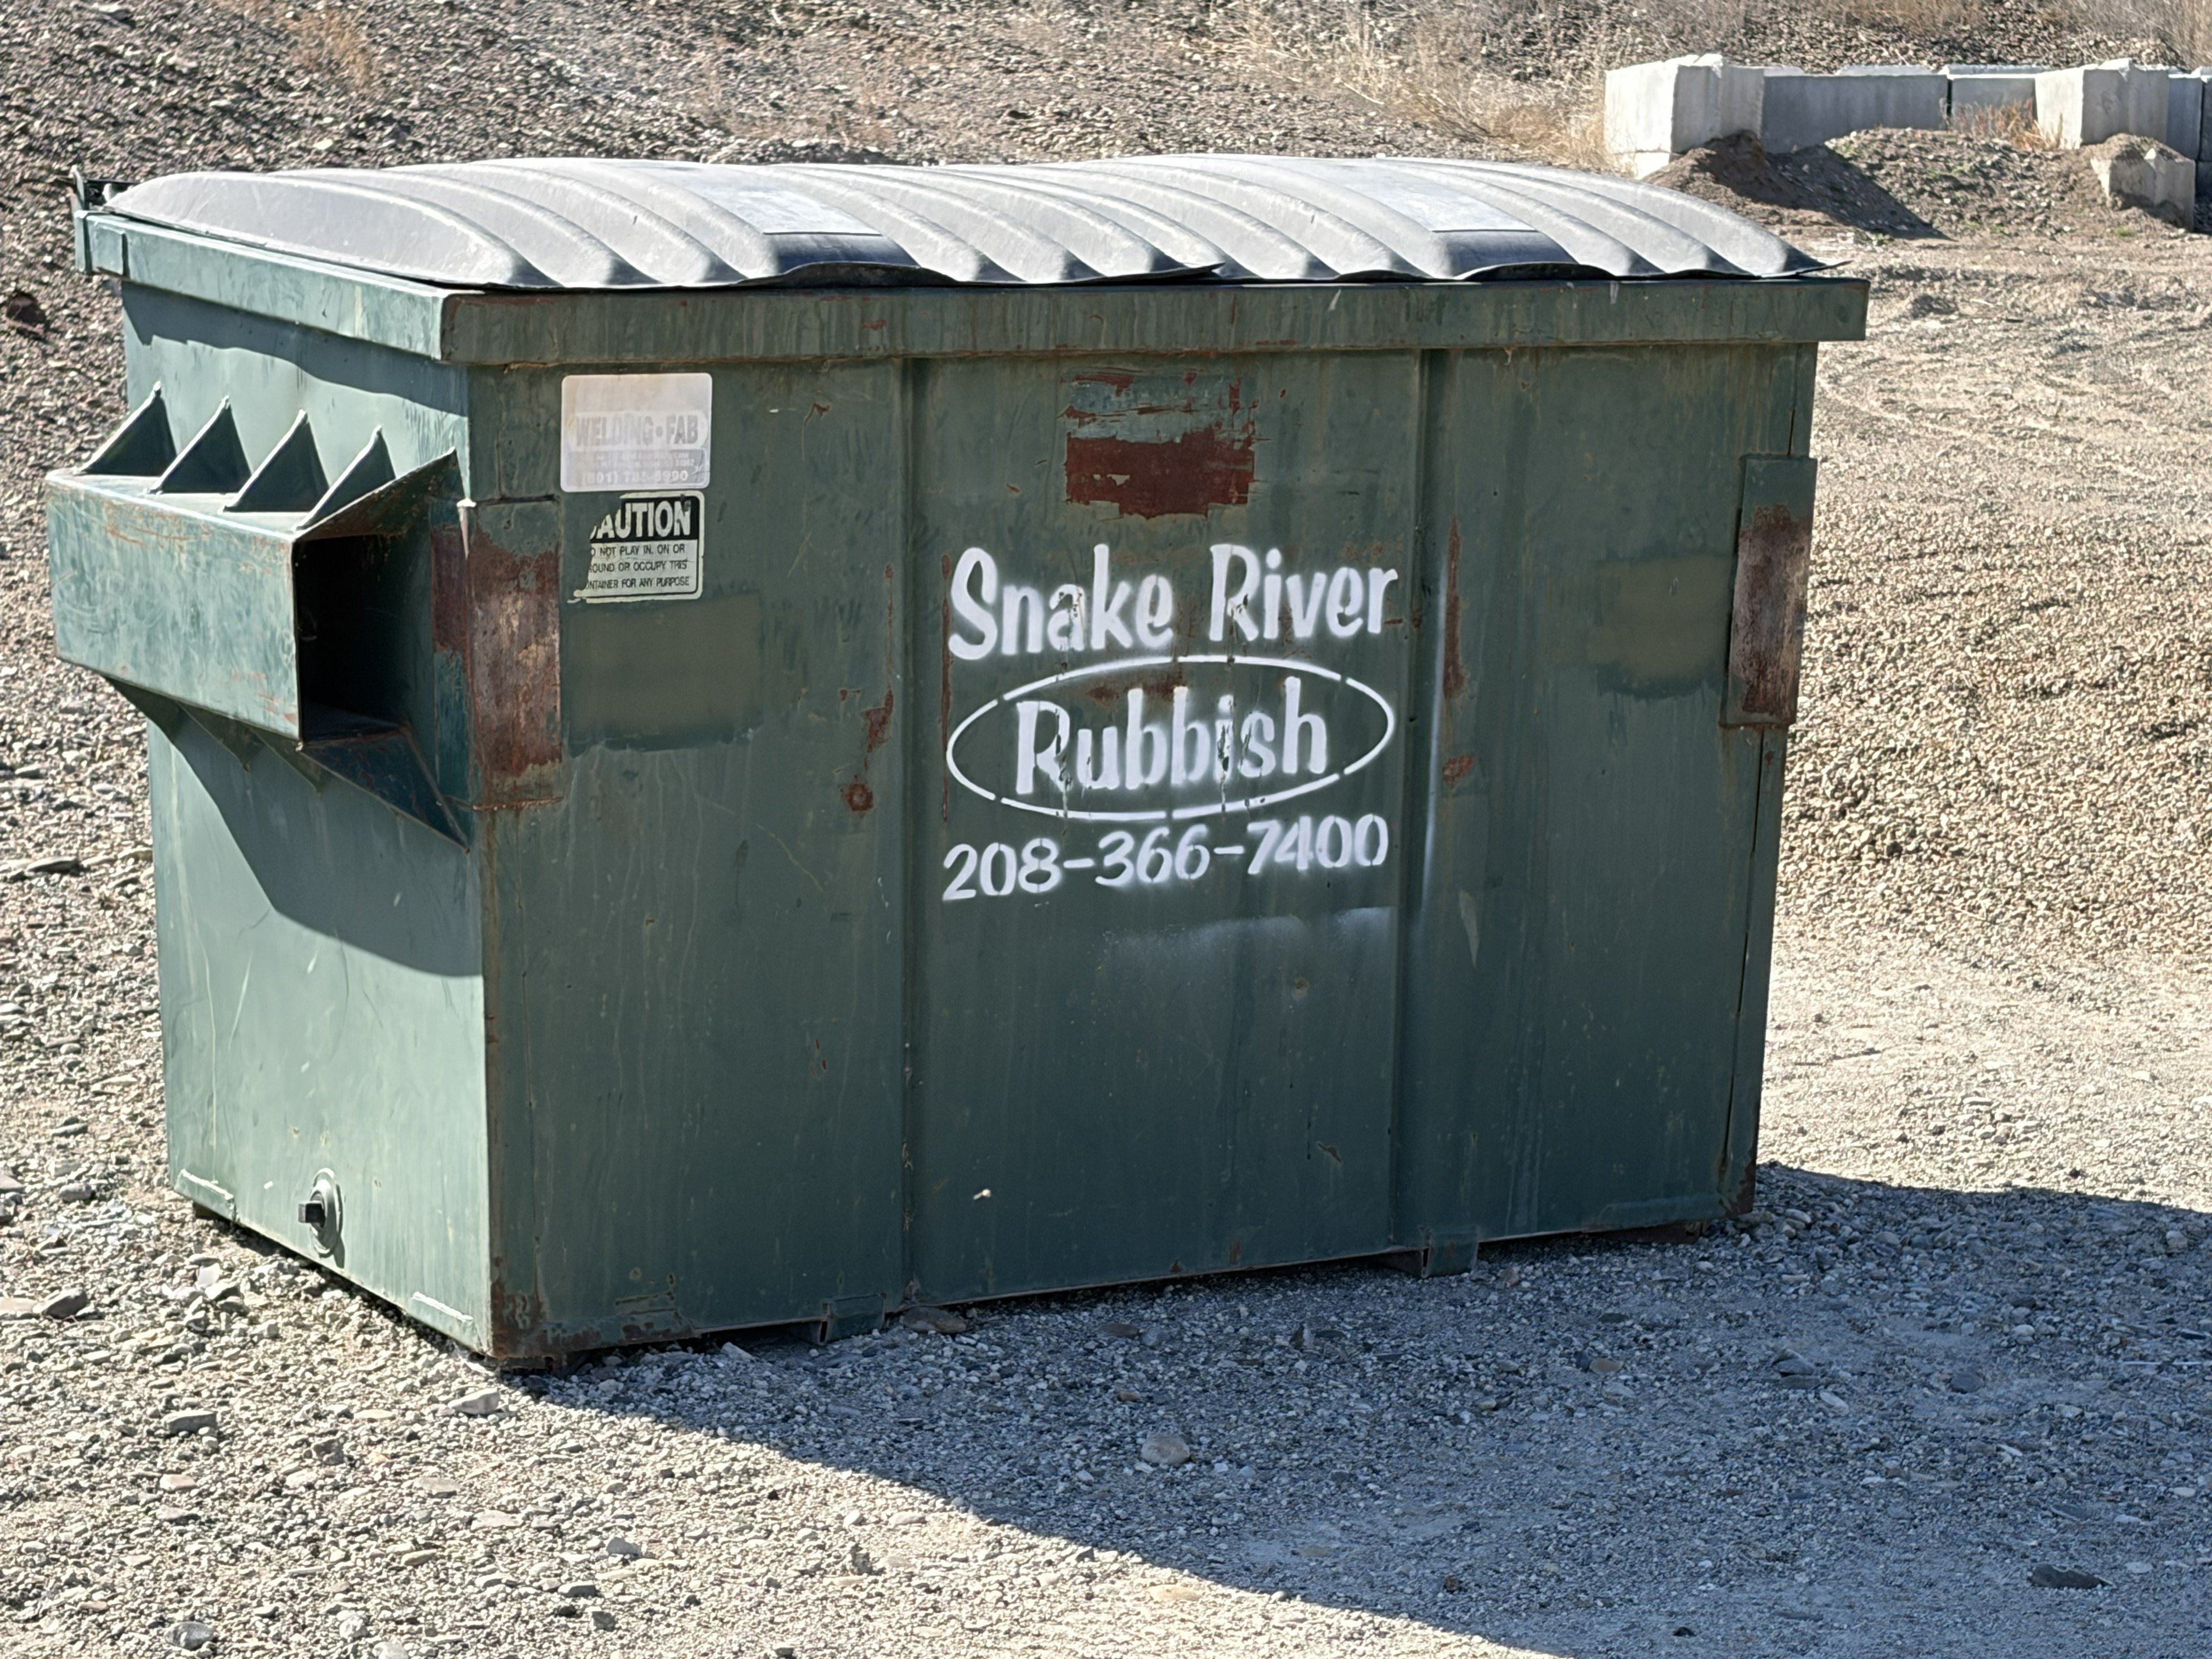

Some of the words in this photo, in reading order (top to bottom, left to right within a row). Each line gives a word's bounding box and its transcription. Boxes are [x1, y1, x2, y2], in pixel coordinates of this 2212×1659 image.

[590, 500, 691, 539] AUTION
[599, 546, 617, 556] NOT
[619, 546, 640, 556] PLAY
[657, 544, 671, 554] ON
[673, 544, 685, 554] OR
[618, 562, 630, 572] OR
[634, 561, 666, 571] OCCUPY
[670, 560, 687, 569] THIS
[586, 579, 618, 590] NTAINER
[621, 578, 636, 588] FOR
[639, 577, 653, 587] ANY
[656, 576, 689, 587] PURPOSE
[949, 543, 1173, 660] Snake
[1209, 543, 1399, 642] River
[1015, 676, 1328, 795] Rubbish
[943, 814, 1389, 901] 208-366-7400
